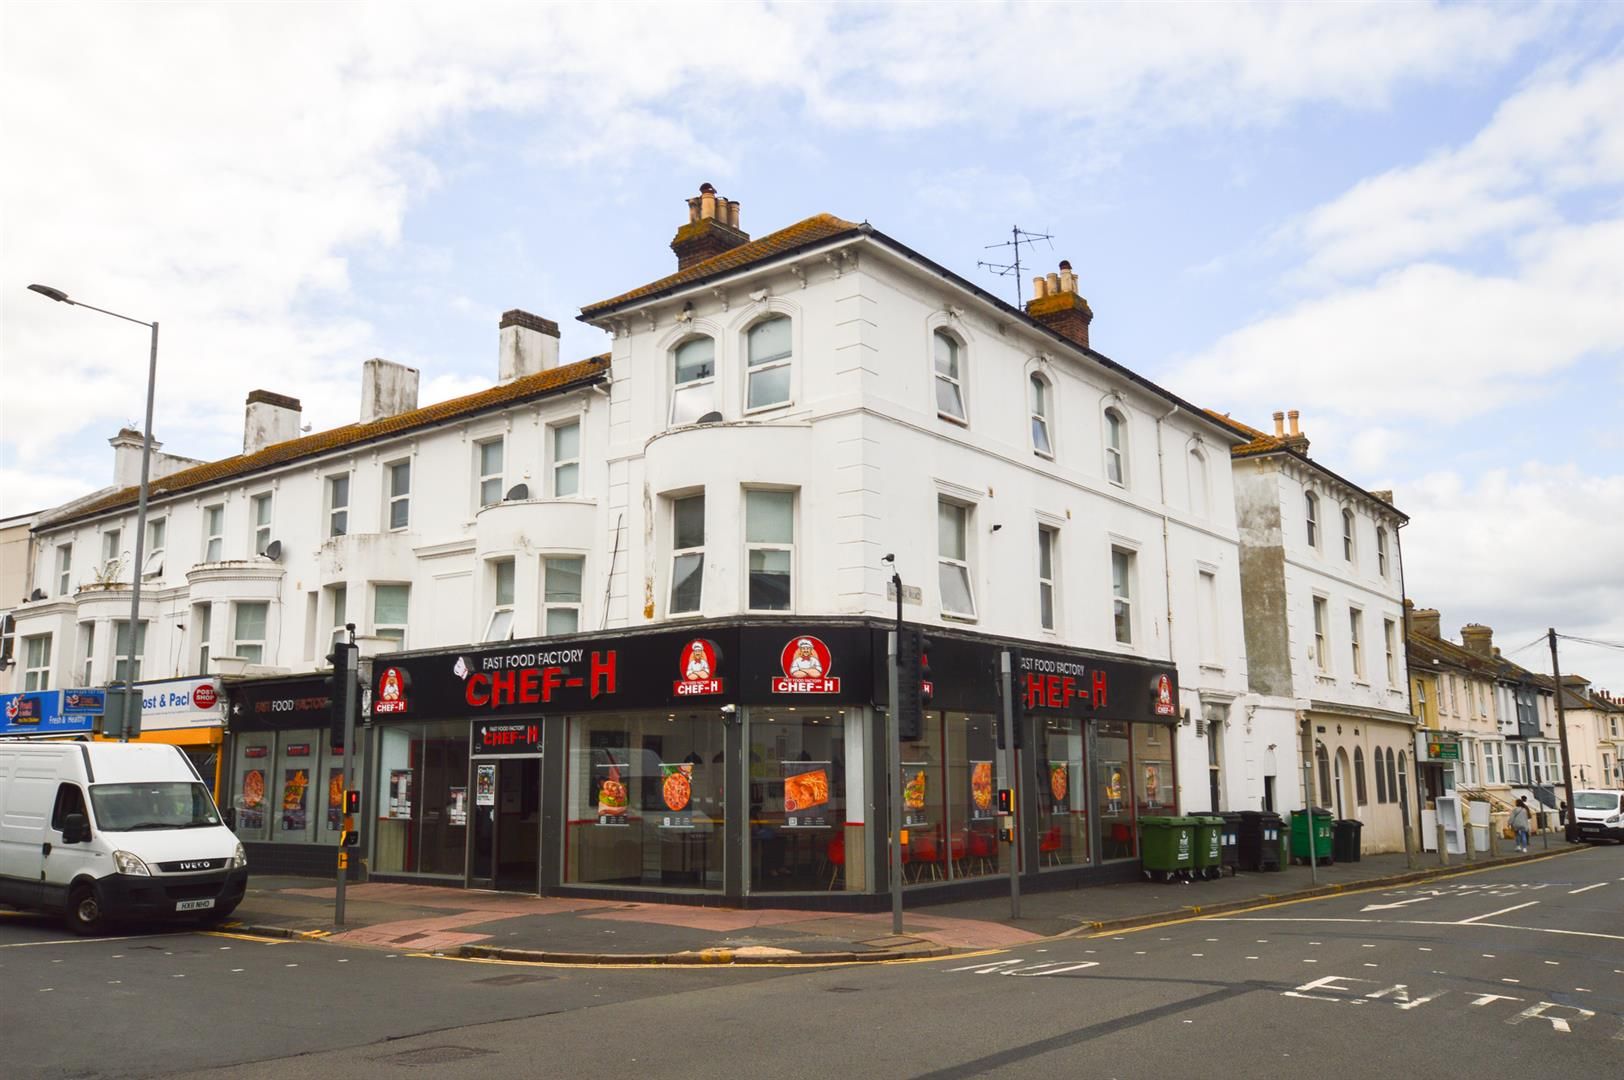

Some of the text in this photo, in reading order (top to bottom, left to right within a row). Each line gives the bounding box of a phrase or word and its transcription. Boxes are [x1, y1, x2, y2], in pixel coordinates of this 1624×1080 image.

[483, 650, 583, 670] FAST FOOD FACTORY
[1020, 657, 1085, 676] AST FOOD FACTORY
[465, 650, 617, 709] CHEF-H
[778, 680, 834, 692] CHEF-H
[678, 681, 718, 695] CHEF-H
[1020, 670, 1107, 710] HEF-H
[142, 696, 157, 709] ost
[159, 694, 167, 708] &
[272, 699, 294, 712] FOOD
[377, 701, 404, 712] CHEF-H
[483, 725, 539, 747] CHEF-H
[180, 861, 210, 870] IVECO
